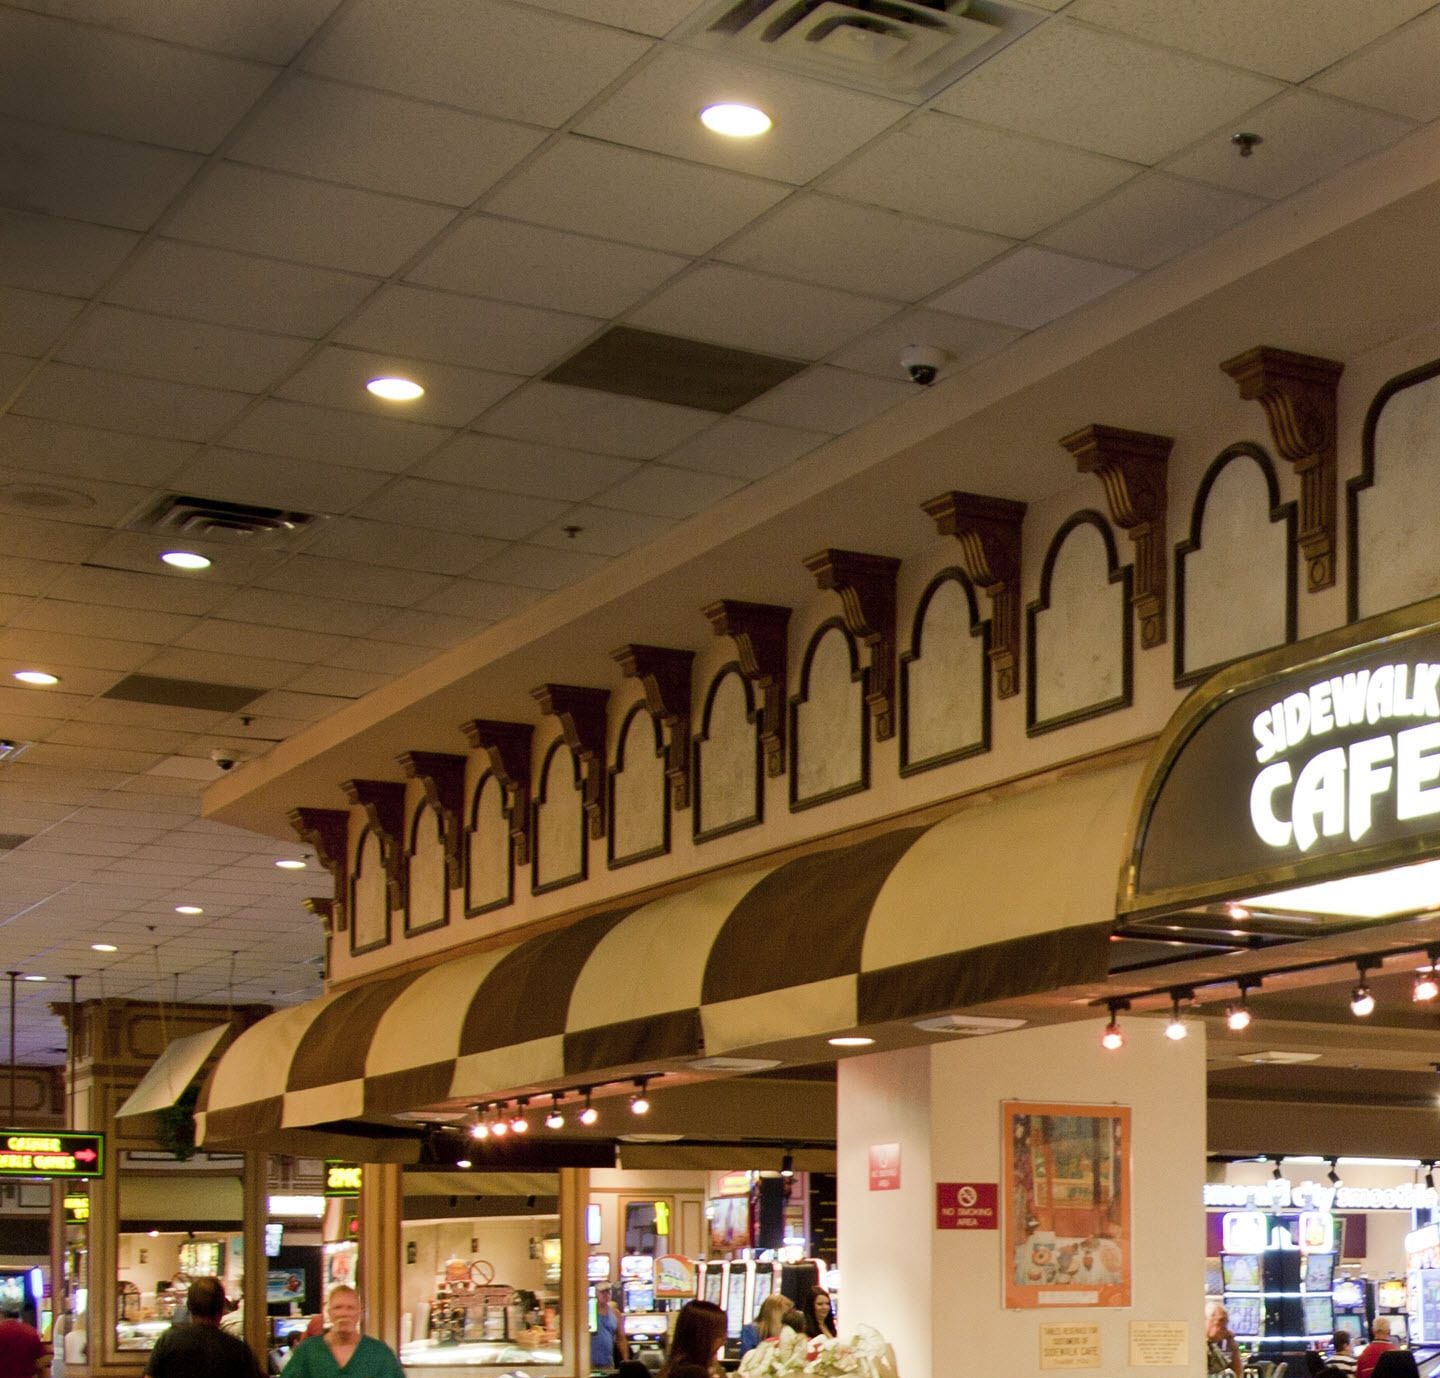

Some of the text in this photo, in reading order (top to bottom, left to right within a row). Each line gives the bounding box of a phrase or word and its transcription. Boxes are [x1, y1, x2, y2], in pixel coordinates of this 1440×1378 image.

[942, 1207, 993, 1217] NO SMOKING
[956, 1217, 979, 1226] AREA
